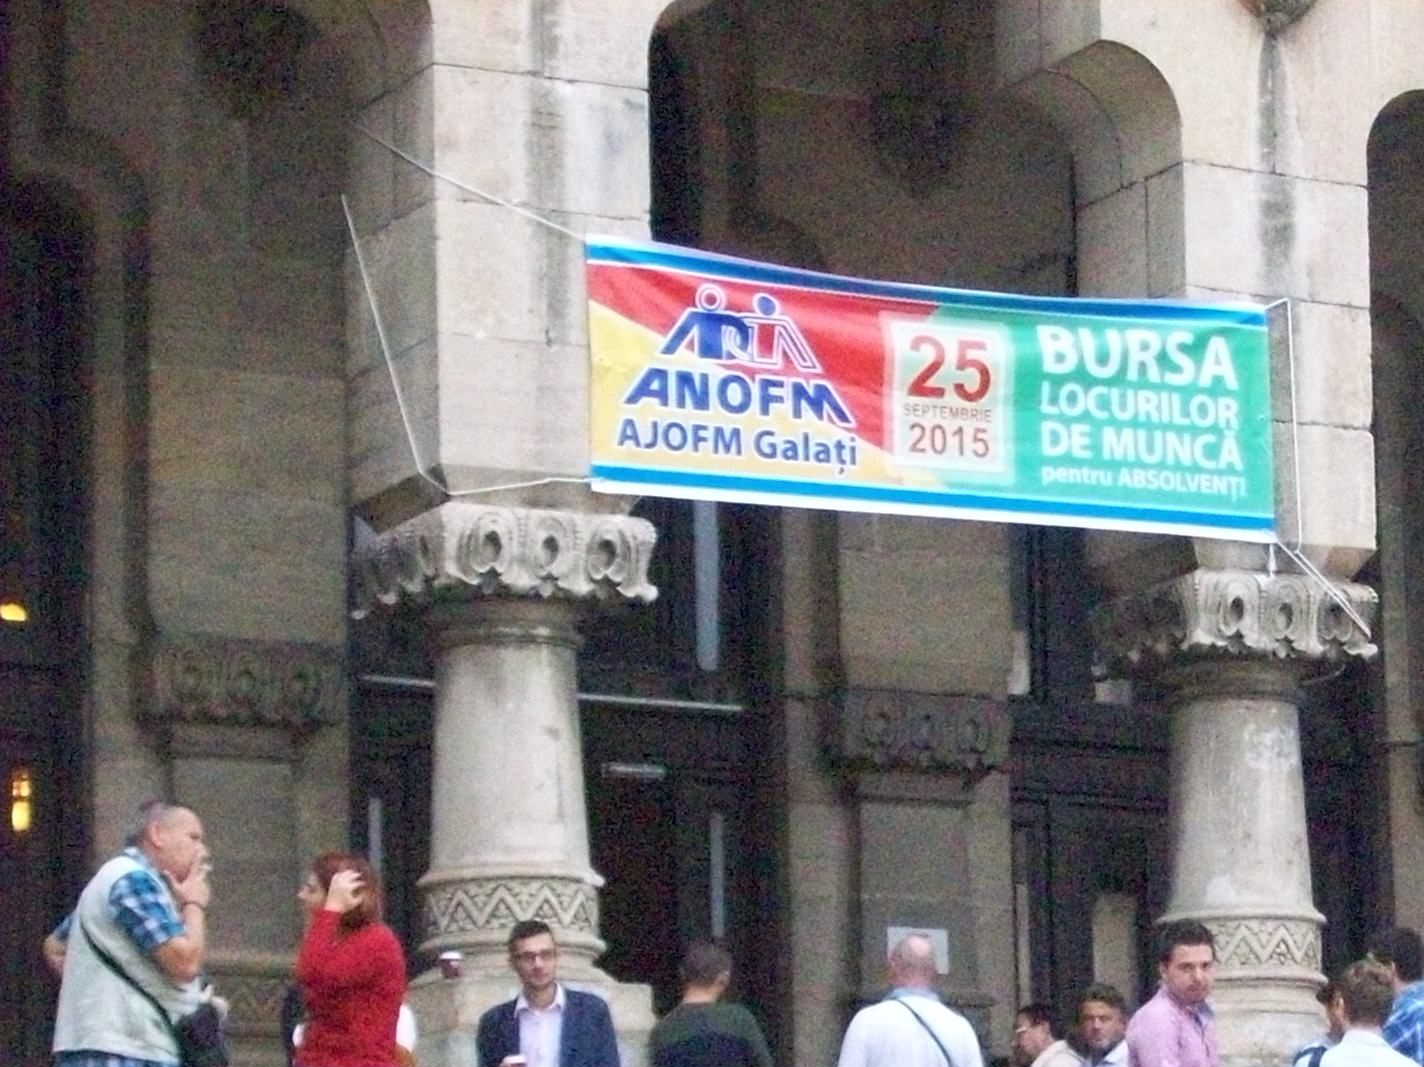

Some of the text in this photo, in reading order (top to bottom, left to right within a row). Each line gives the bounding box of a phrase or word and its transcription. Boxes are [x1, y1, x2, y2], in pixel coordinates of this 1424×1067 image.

[906, 334, 991, 402] 25
[1037, 325, 1239, 391] BURSA
[623, 367, 853, 425] ANOFM
[903, 402, 992, 423] SEPTEMBRIE
[1040, 381, 1240, 430] LOCURILOR
[617, 418, 743, 457] AJOFM
[908, 422, 990, 458] 2015
[1041, 420, 1244, 471] DE MUNCĂ
[1041, 466, 1113, 486] pentru
